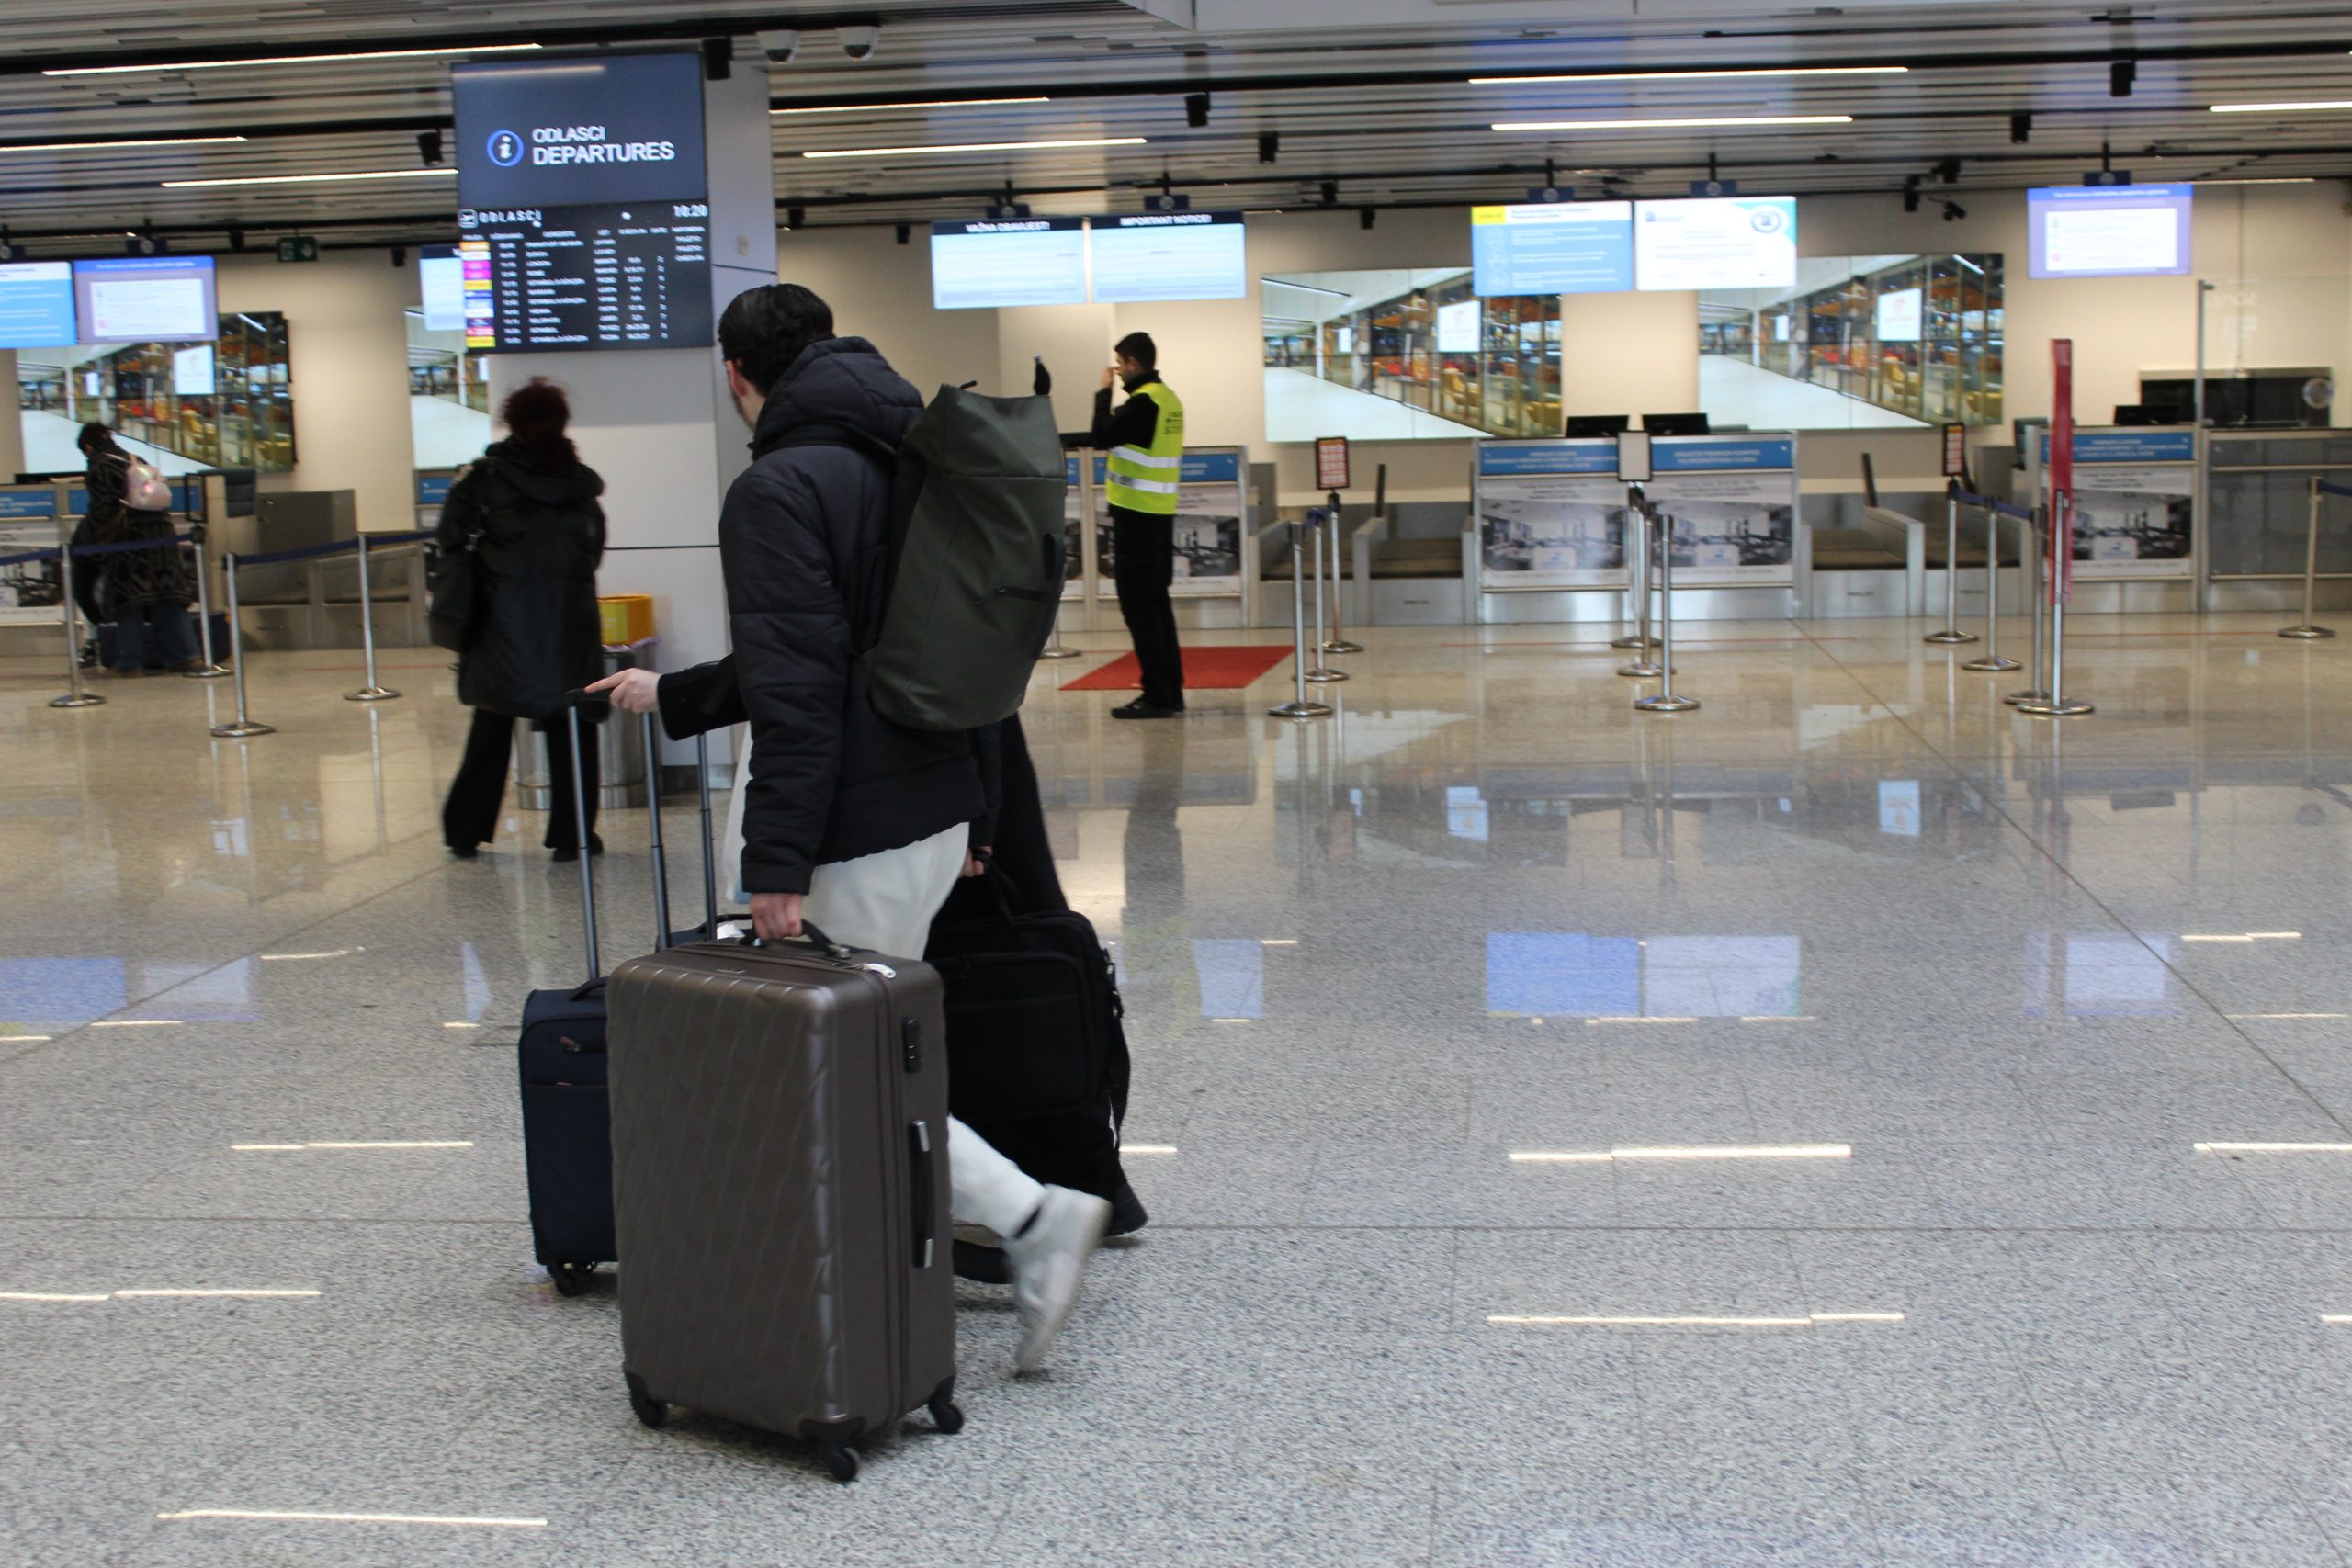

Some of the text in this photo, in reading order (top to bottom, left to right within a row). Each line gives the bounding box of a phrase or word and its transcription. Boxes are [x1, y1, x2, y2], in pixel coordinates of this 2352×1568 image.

[533, 126, 605, 142] ODLASCI
[533, 141, 675, 165] DEPARTURES
[479, 209, 542, 222] ODLASCI
[1120, 216, 1172, 227] IMPORTANT
